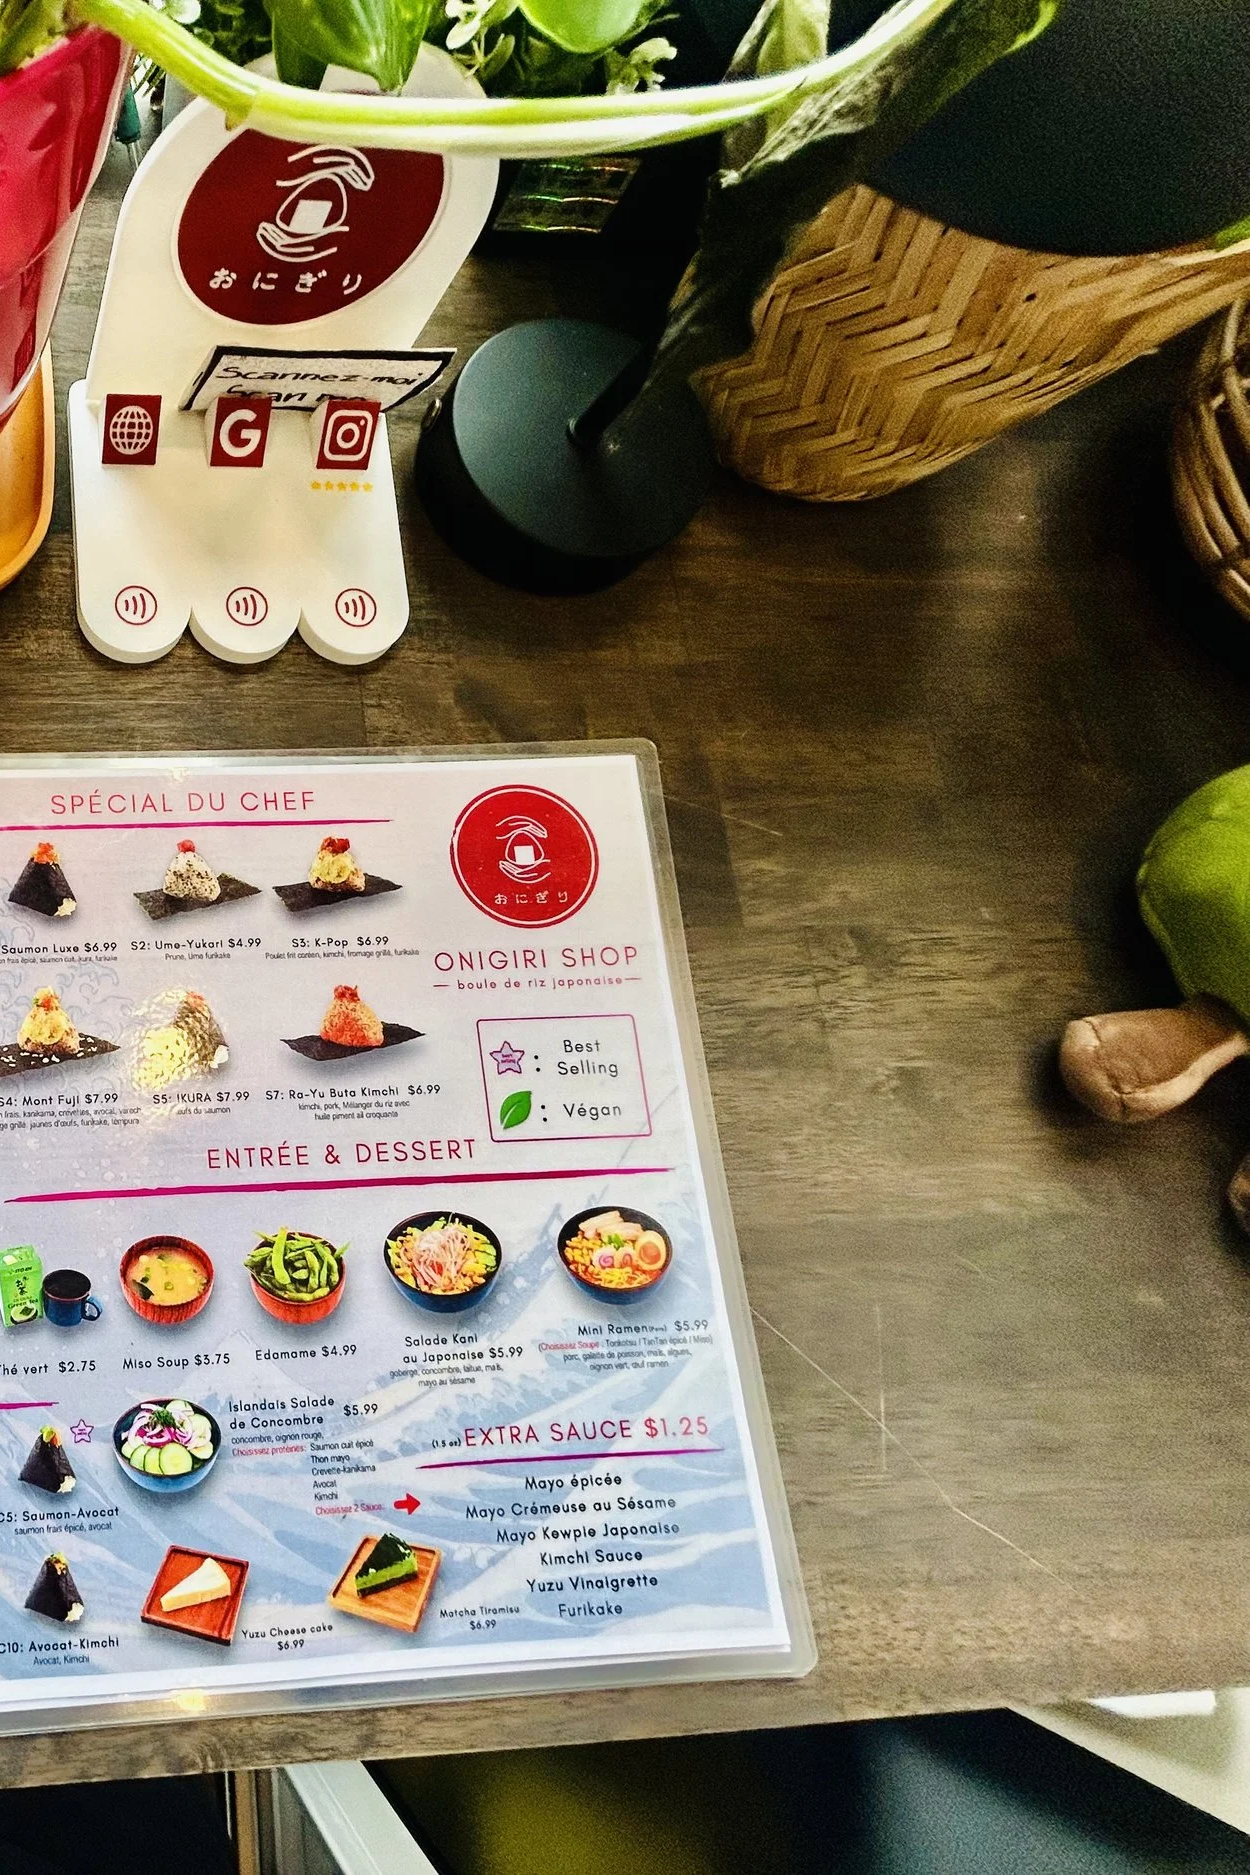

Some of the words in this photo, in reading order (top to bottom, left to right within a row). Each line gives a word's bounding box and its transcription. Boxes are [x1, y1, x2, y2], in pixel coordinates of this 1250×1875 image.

[209, 268, 362, 295] おにぎり
[216, 366, 423, 386] Scannez-moi
[50, 790, 173, 814] SPÉCIAL
[188, 792, 226, 812] DU
[240, 791, 314, 811] CHEF
[494, 890, 568, 905] おにぎり
[2, 944, 48, 955] Saumon
[53, 944, 79, 954] Luxe
[84, 942, 118, 953] $6.99
[130, 940, 151, 951] S2:
[155, 938, 224, 950] Ume-Yukari
[228, 937, 262, 948] $4.99
[292, 938, 310, 948] S3:
[314, 937, 348, 950] K-Pop
[356, 936, 389, 946] $6.99
[434, 949, 547, 972] ONIGIRI
[562, 946, 638, 968] SHOP
[458, 979, 497, 990] boule
[504, 977, 520, 988] de
[528, 978, 546, 988] riz
[552, 976, 623, 990] japonaise
[563, 1039, 600, 1053] Best
[557, 1060, 618, 1078] Selling
[22, 1096, 54, 1106] Mont
[58, 1094, 81, 1106] Fuji
[84, 1093, 118, 1105] $7.99
[152, 1094, 172, 1104] S5:
[216, 1091, 250, 1102] $7.99
[266, 1090, 284, 1100] S7:
[289, 1088, 326, 1100] Ra-Yu
[330, 1088, 356, 1098] Buta
[360, 1086, 399, 1097] Kimchi
[408, 1084, 441, 1096] $6.99
[563, 1102, 622, 1120] Végan
[207, 1140, 310, 1169] ENTRÉE
[324, 1144, 341, 1164] &
[356, 1138, 476, 1163] DESSERT
[578, 1325, 602, 1335] Mini
[608, 1323, 648, 1334] Ramen
[674, 1320, 709, 1332] $5.99
[404, 1334, 448, 1346] Salade
[452, 1333, 478, 1344] Kani
[255, 1348, 317, 1360] Edamame
[322, 1344, 357, 1357] $4.99
[402, 1353, 418, 1364] au
[422, 1350, 484, 1364] Japonaise
[489, 1346, 523, 1358] $5.99
[24, 1364, 48, 1374] vert
[58, 1360, 96, 1373] $2.75
[122, 1358, 152, 1370] Miso
[157, 1356, 190, 1370] Soup
[194, 1353, 230, 1366] $3.75
[229, 1400, 286, 1412] Islandais
[290, 1396, 334, 1408] Salade
[344, 1404, 378, 1416] $5.99
[230, 1418, 246, 1430] de
[250, 1415, 324, 1428] Concombre
[464, 1424, 539, 1447] EXTRA
[550, 1420, 633, 1442] SAUCE
[644, 1416, 710, 1439] $1.25
[525, 1476, 564, 1492] Mayo
[570, 1472, 622, 1490] épicée
[22, 1507, 120, 1522] Saumon-Avocat
[466, 1506, 505, 1522] Mayo
[592, 1501, 612, 1512] au
[617, 1495, 676, 1510] Sésame
[496, 1529, 536, 1545] Mayo
[542, 1526, 596, 1542] Kewpie
[602, 1522, 680, 1539] Japonaise
[540, 1551, 590, 1566] Kimchi
[594, 1548, 643, 1562] Sauce
[526, 1578, 564, 1592] Yuzu
[569, 1574, 658, 1592] Vinaigrette
[440, 1608, 476, 1618] Matcha
[480, 1606, 520, 1616] Tiramisu
[558, 1602, 622, 1618] Furikake
[242, 1629, 266, 1640] Yuzu
[270, 1626, 307, 1637] Cheese
[310, 1623, 333, 1633] cake
[470, 1619, 496, 1630] $6.99
[28, 1637, 120, 1652] Avocat-Kimchi
[277, 1639, 305, 1651] $6.99
